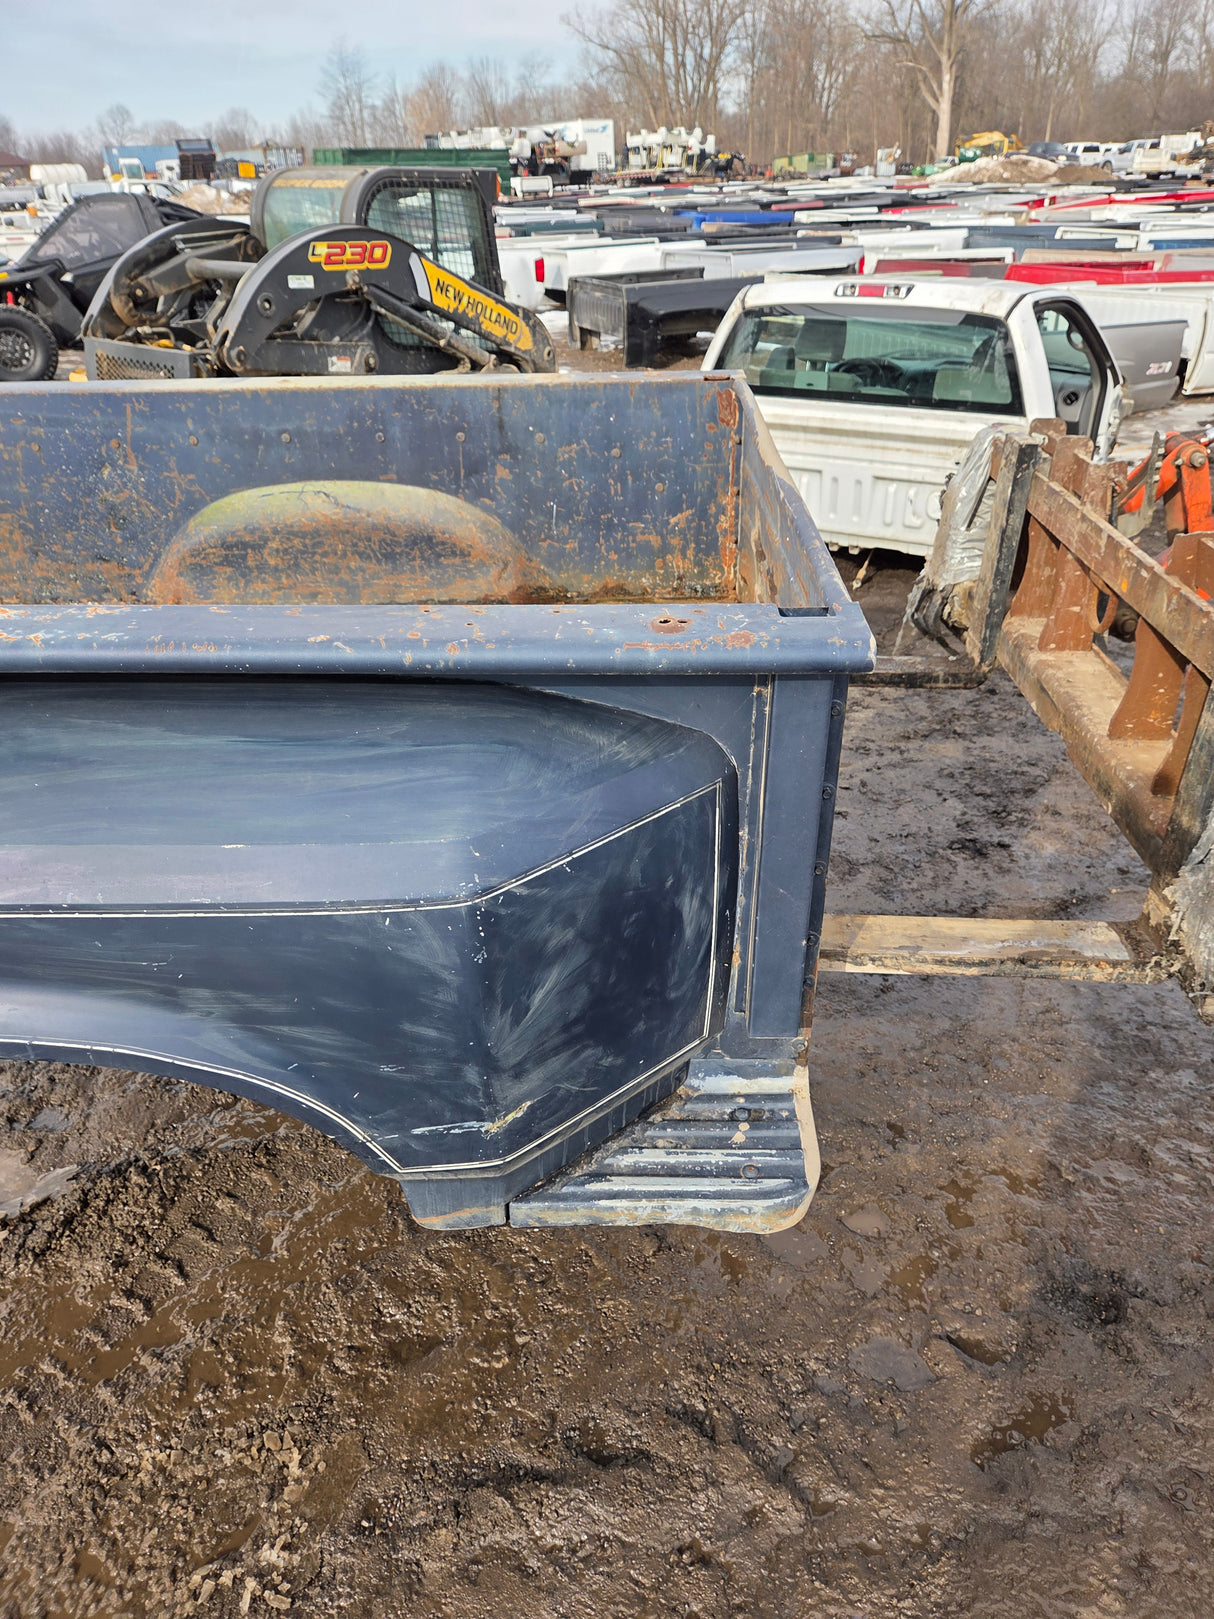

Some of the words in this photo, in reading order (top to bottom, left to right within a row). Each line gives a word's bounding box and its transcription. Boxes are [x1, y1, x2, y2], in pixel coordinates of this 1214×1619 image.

[310, 242, 390, 267] L230
[435, 277, 465, 306] NEW
[466, 295, 519, 335] HOLLAND
